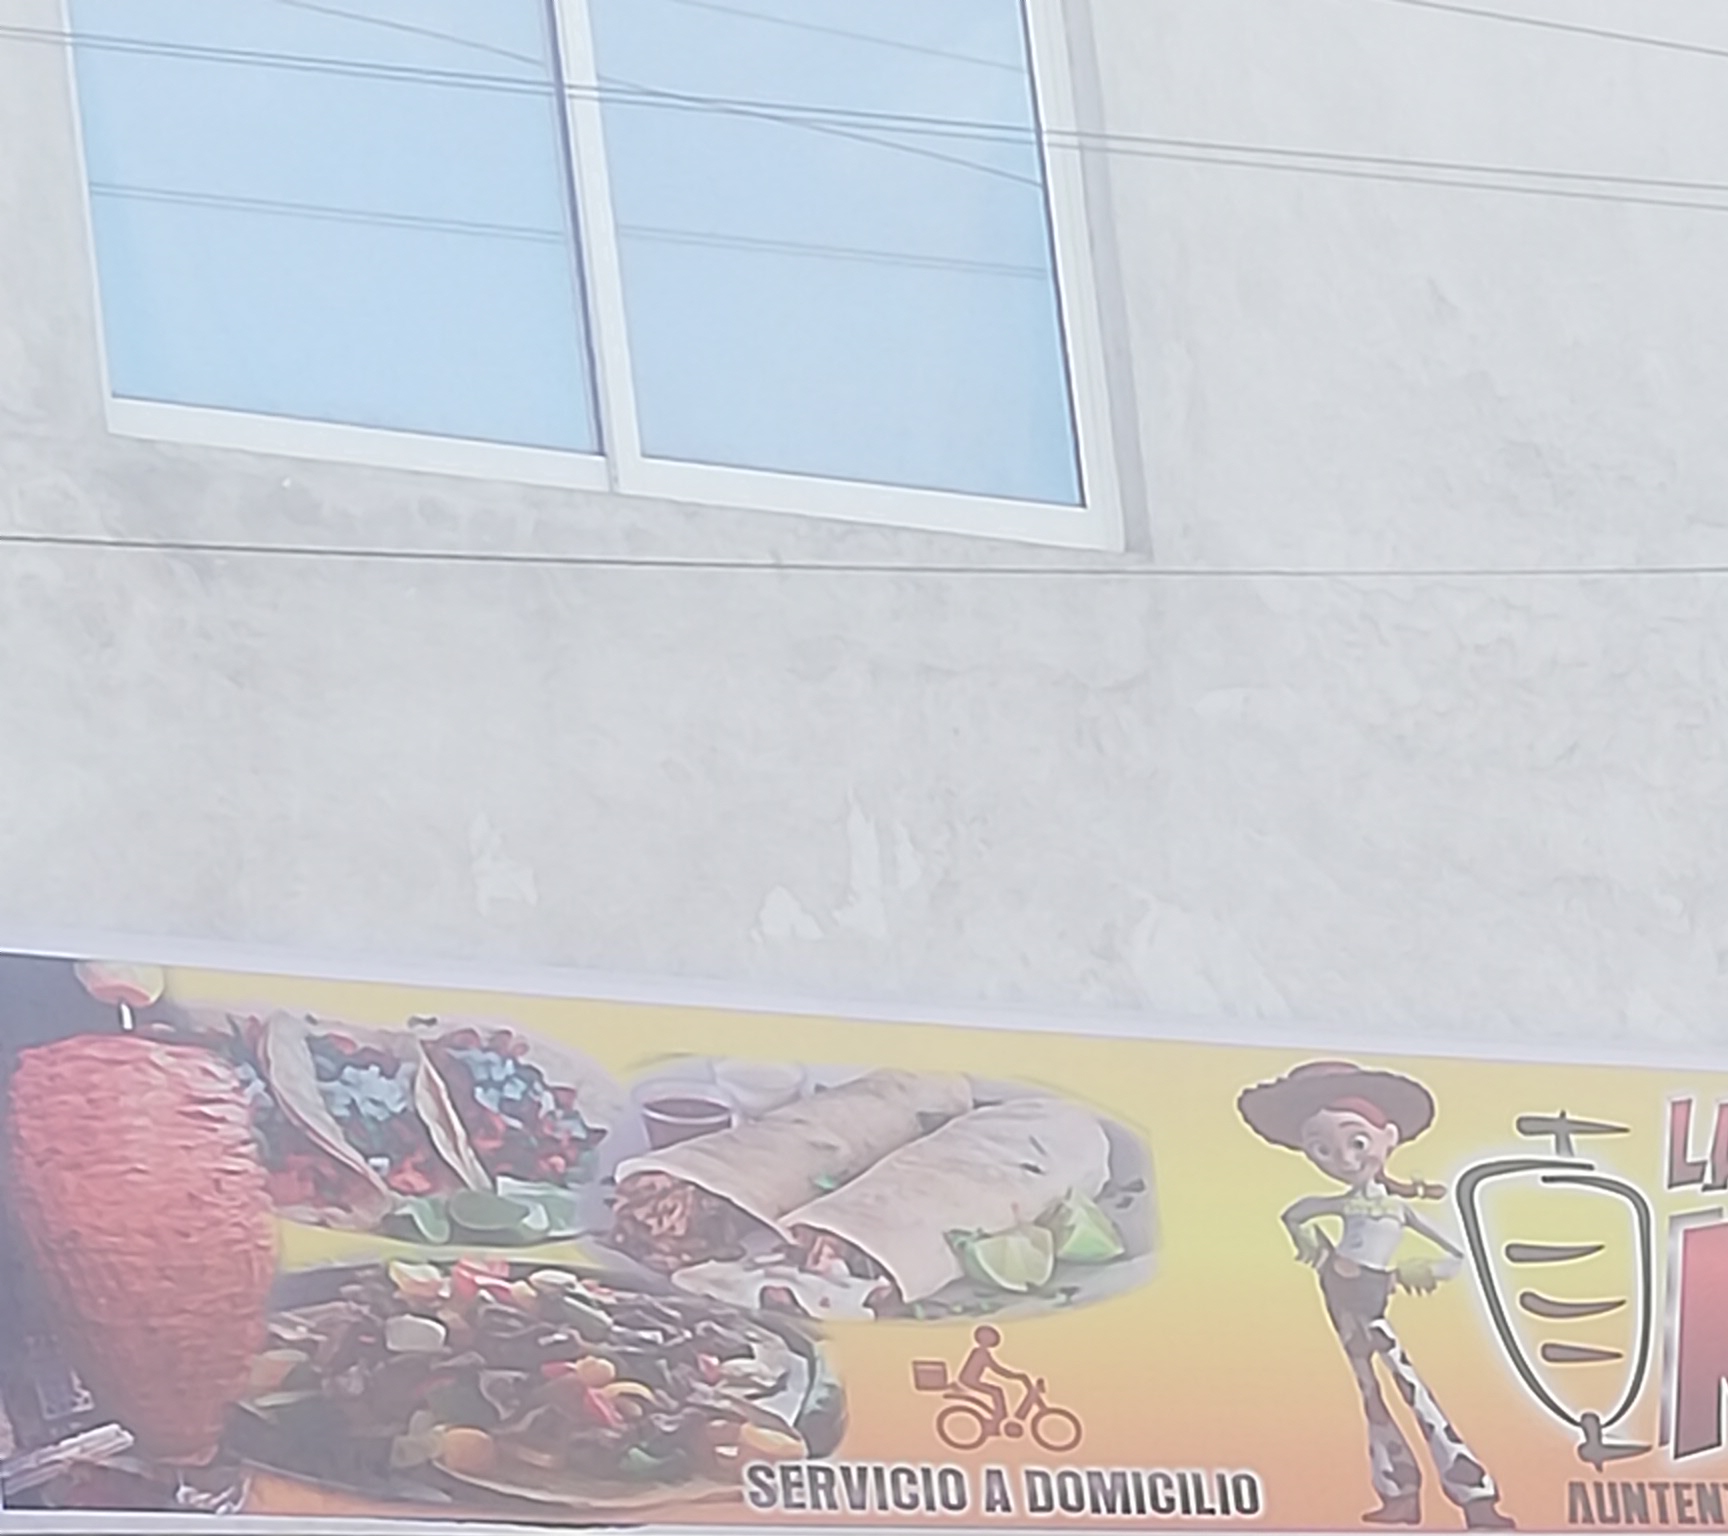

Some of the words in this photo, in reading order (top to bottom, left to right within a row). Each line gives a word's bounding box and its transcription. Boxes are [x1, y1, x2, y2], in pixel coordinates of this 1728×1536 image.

[747, 1465, 966, 1512] SERVICIO
[985, 1467, 1012, 1513] A
[1025, 1469, 1259, 1516] DOMICILIO
